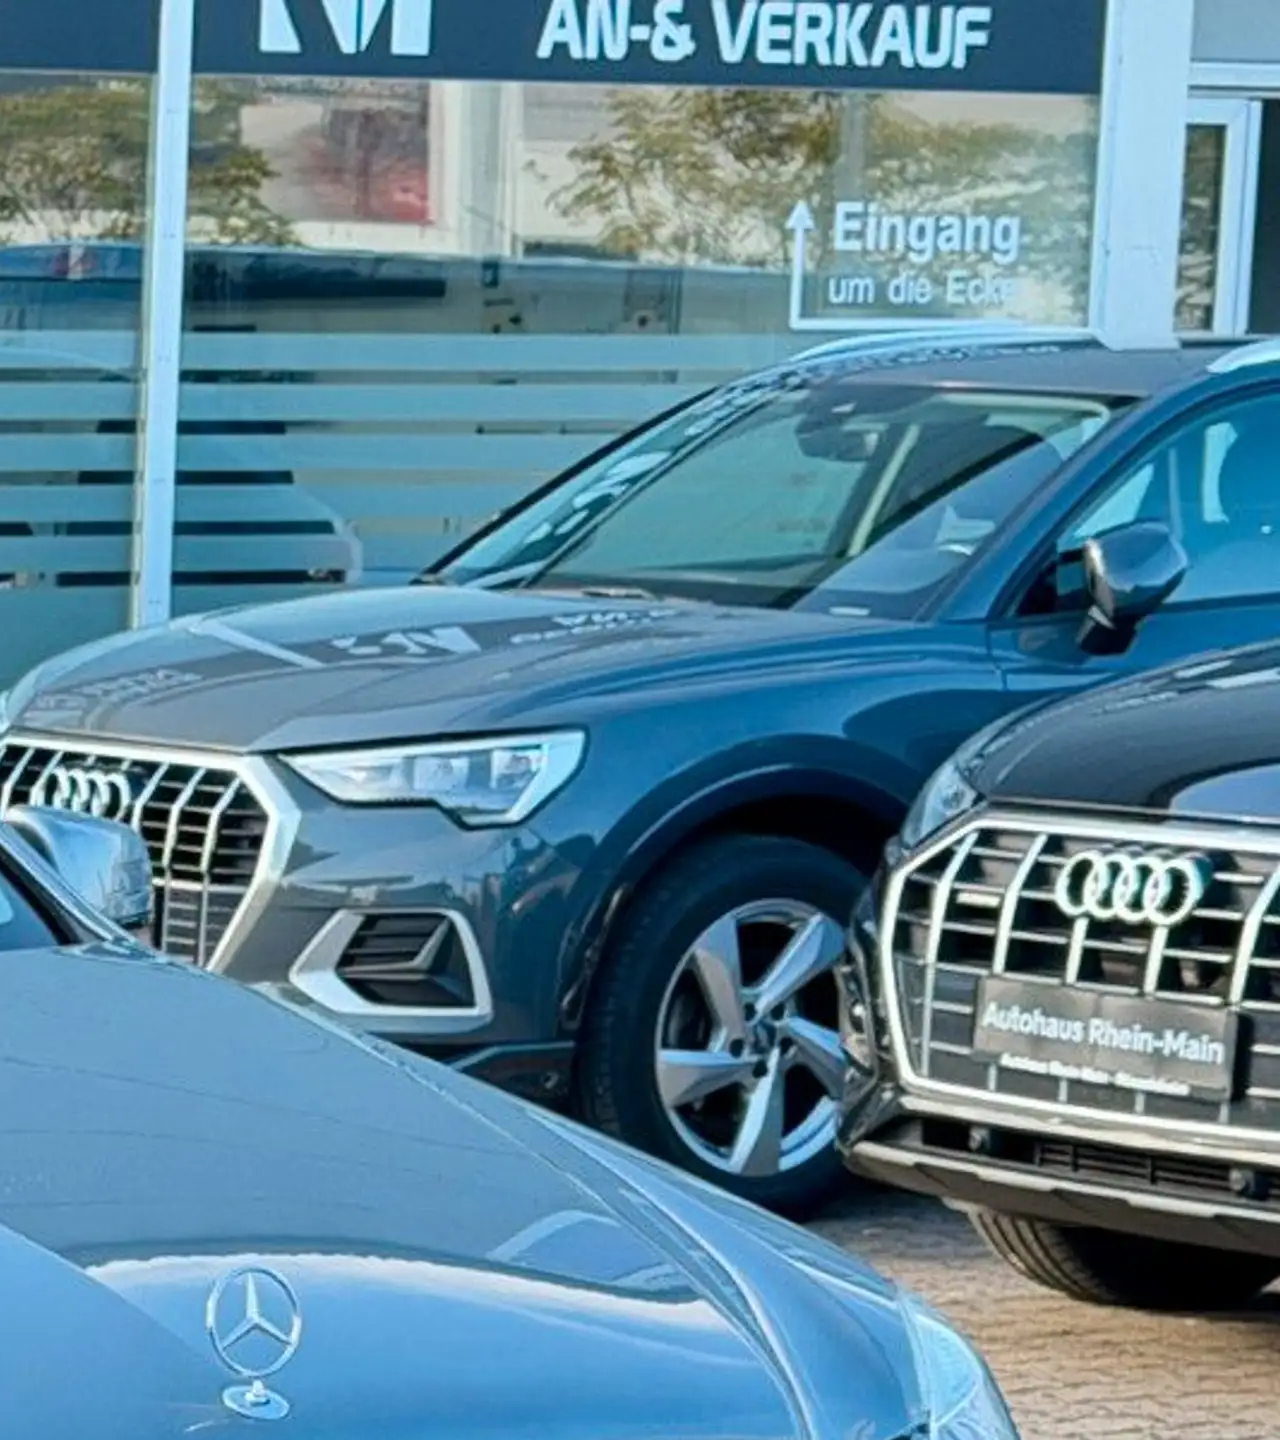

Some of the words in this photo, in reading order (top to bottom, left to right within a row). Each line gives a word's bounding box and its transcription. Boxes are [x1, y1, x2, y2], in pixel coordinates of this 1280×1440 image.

[536, 0, 697, 63] AN-&
[710, 0, 992, 70] VERKAUF
[833, 201, 1021, 264] Eingang
[828, 276, 875, 304] um
[888, 268, 933, 304] die
[981, 1002, 1085, 1043] Autohaus
[1089, 1018, 1226, 1065] Rhein-Main
